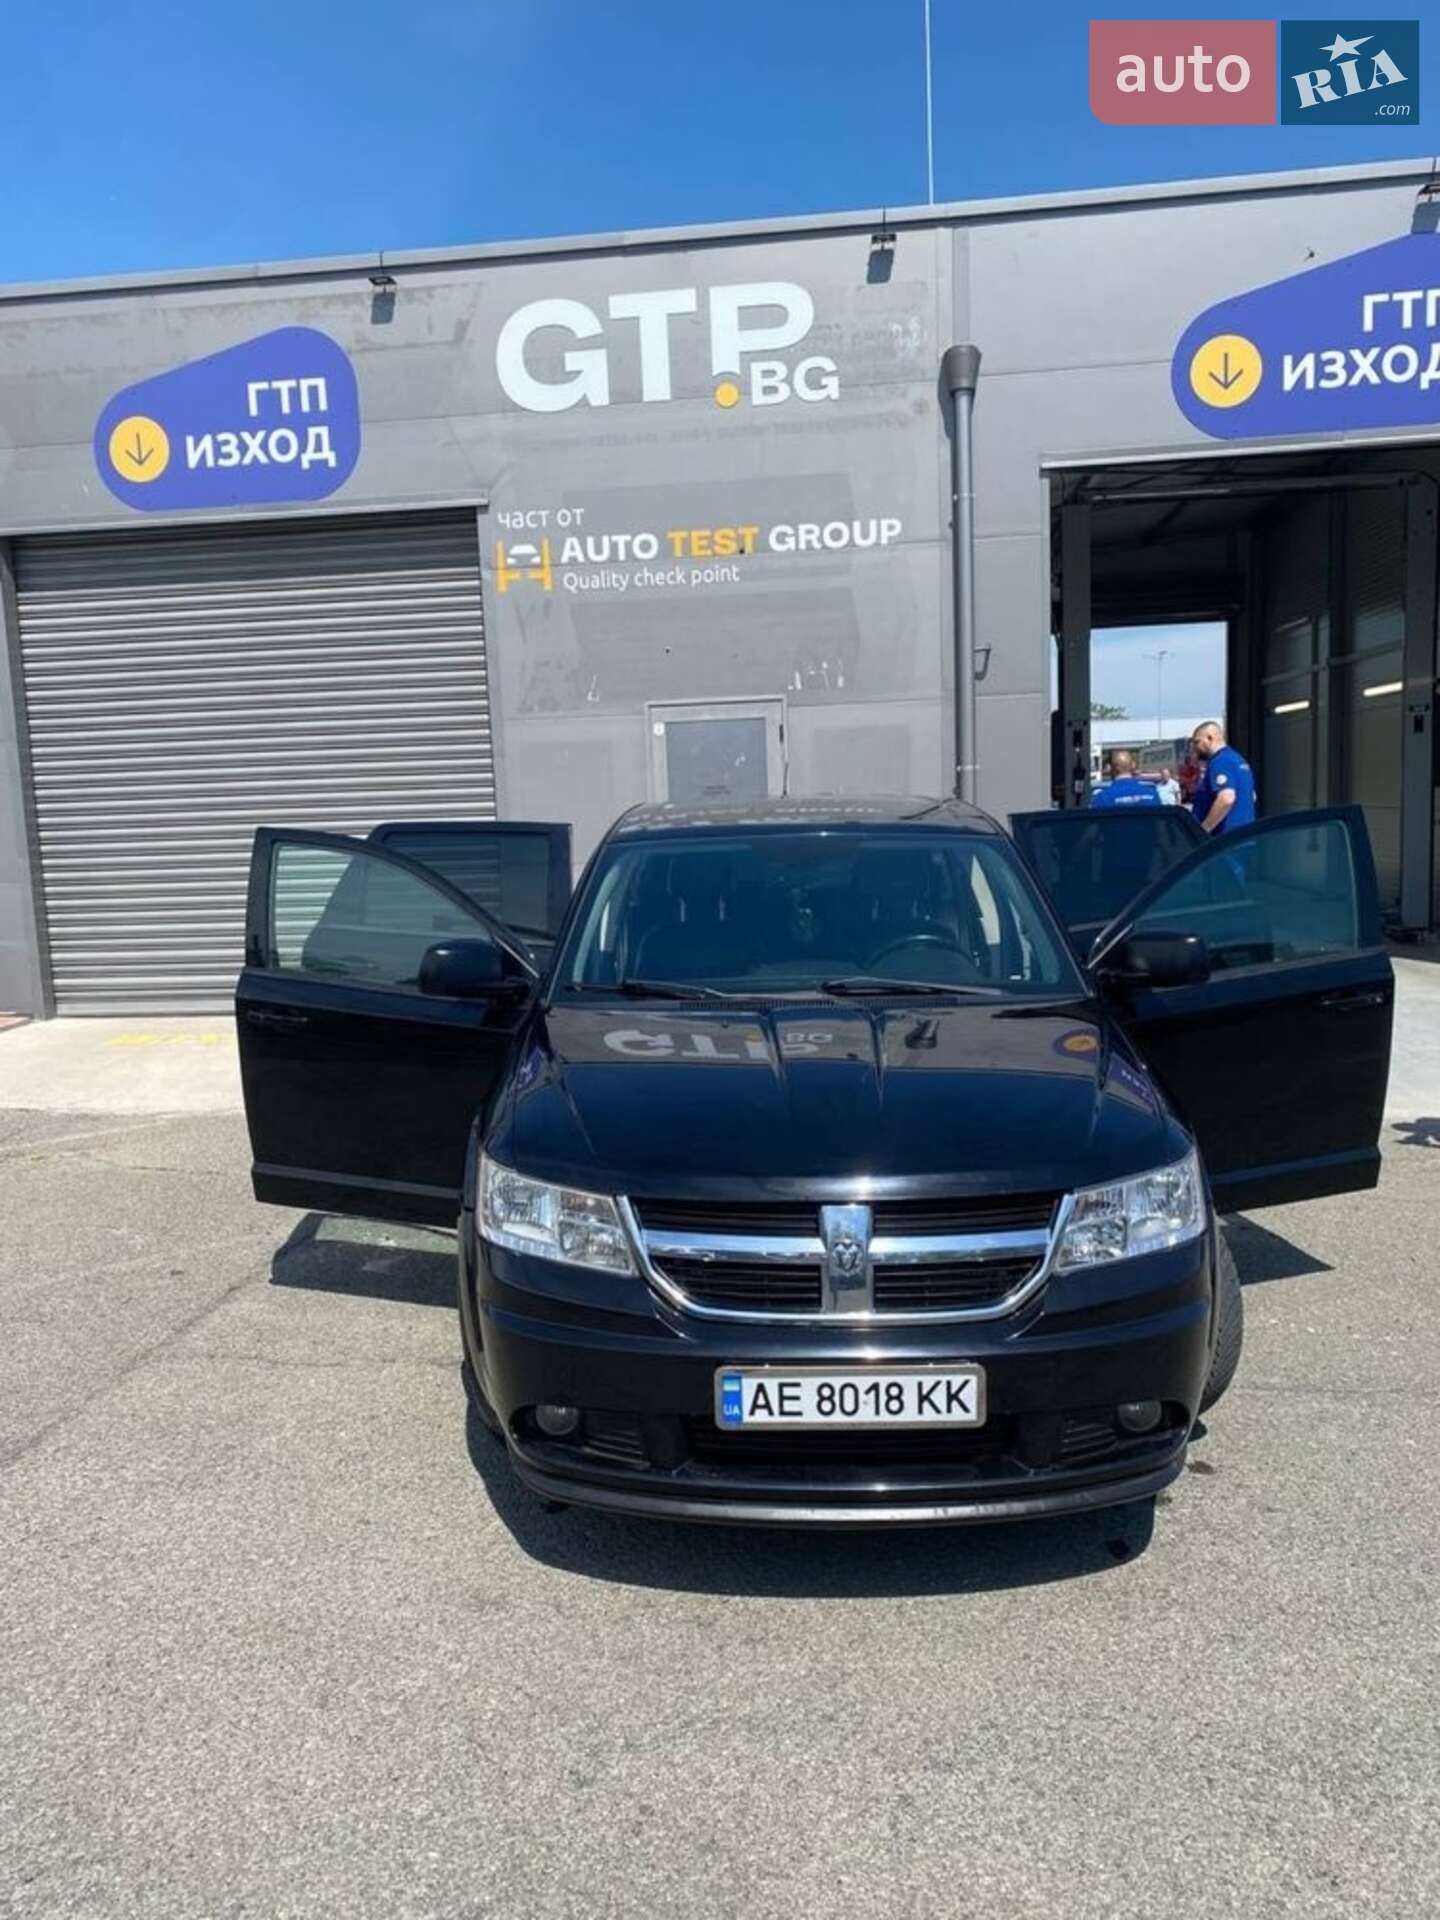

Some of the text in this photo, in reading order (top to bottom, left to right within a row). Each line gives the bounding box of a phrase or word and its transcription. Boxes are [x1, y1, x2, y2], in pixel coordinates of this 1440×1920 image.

[247, 377, 328, 417] ГТП
[185, 426, 337, 469] ИЗХОД
[497, 508, 585, 529] част от
[560, 518, 902, 563] AUTO TEST GROUP
[563, 563, 741, 593] Quality check point
[723, 1404, 741, 1416] UA
[749, 1379, 971, 1416] AE 8018 KK
